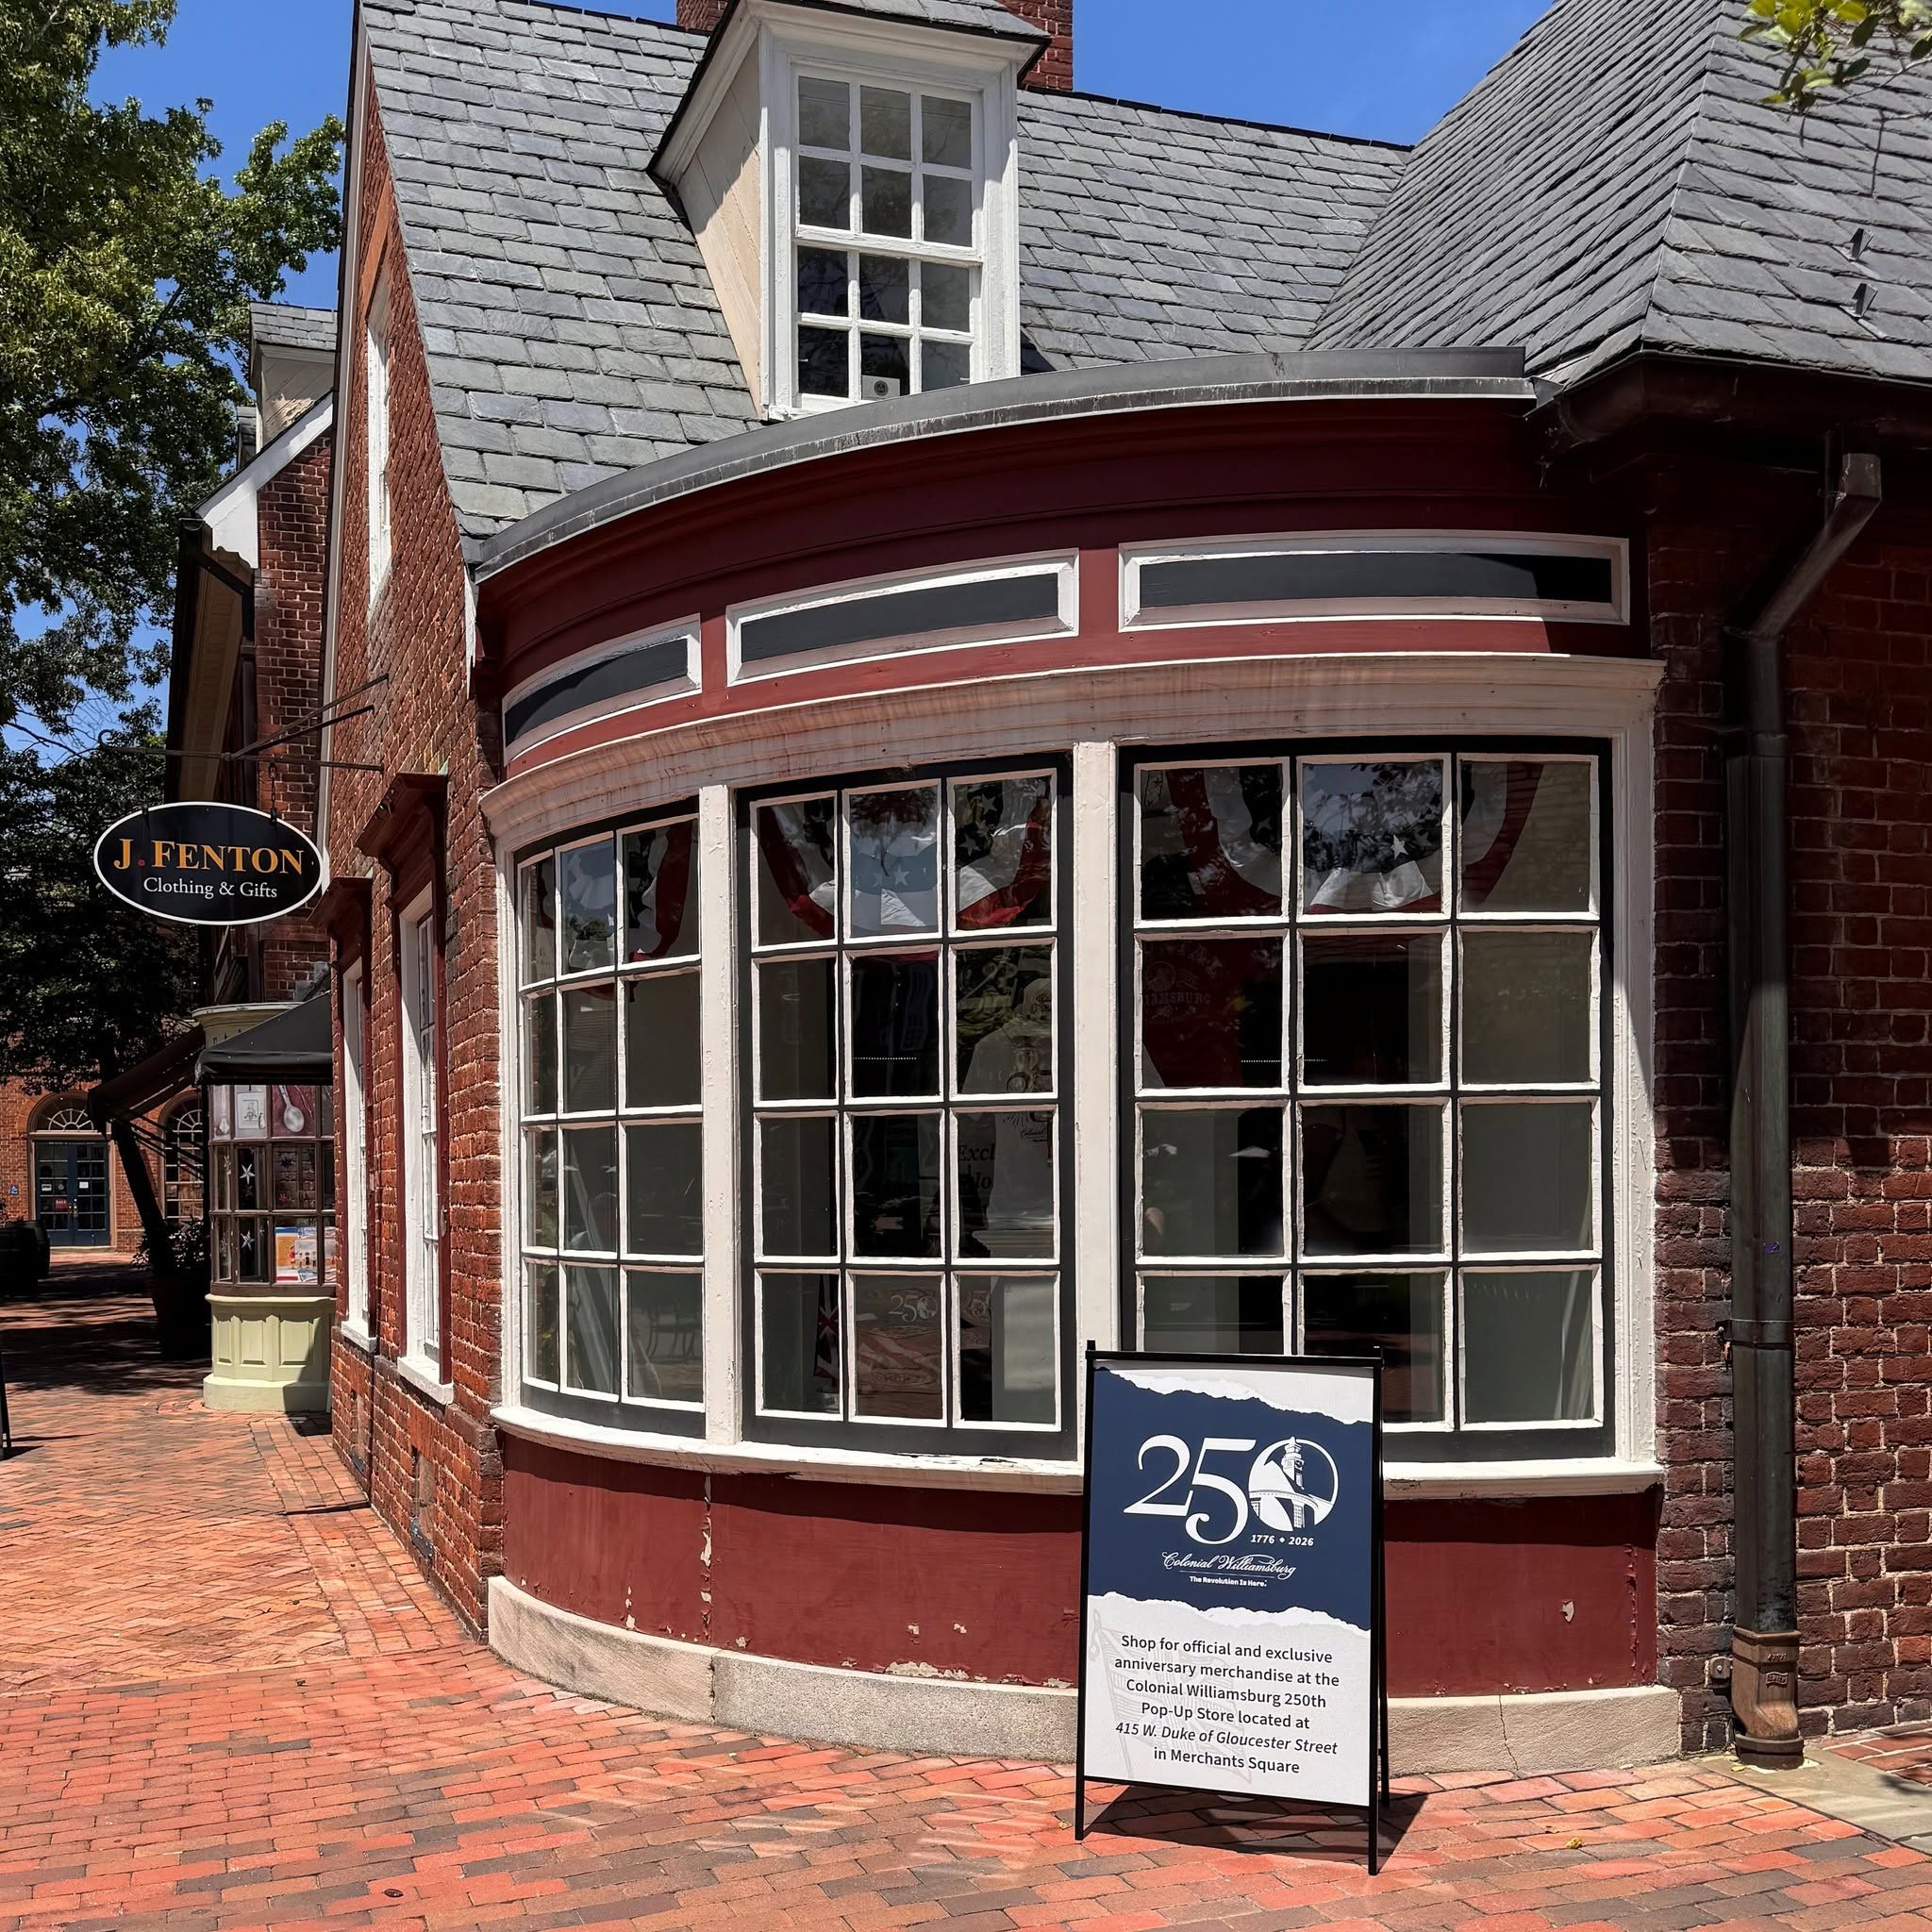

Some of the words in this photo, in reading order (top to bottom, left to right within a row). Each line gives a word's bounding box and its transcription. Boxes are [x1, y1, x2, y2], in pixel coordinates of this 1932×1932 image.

[151, 840, 305, 875] FENTON
[143, 876, 213, 899] Clothing
[219, 881, 235, 895] &
[240, 881, 277, 898] Gifts
[1123, 1434, 1339, 1544] 250
[1251, 1534, 1274, 1544] 1776
[1288, 1537, 1314, 1546] 2026
[1161, 1552, 1219, 1570] Colonial
[1218, 1554, 1296, 1580] Williamsburg
[1203, 1576, 1239, 1585] Revolution
[1121, 1635, 1156, 1650] Shop
[1159, 1638, 1180, 1651] for
[1183, 1641, 1231, 1656] official
[1235, 1645, 1261, 1657] and
[1265, 1647, 1333, 1663] exclusive
[1115, 1657, 1196, 1677] anniversary
[1200, 1665, 1293, 1683] merchandise
[1297, 1674, 1311, 1684] at
[1315, 1673, 1340, 1687] the
[1126, 1679, 1183, 1696] Colonial
[1186, 1684, 1281, 1707] Williamsburg
[1284, 1693, 1326, 1707] 250th
[1141, 1703, 1193, 1721] Pop-Up
[1197, 1707, 1234, 1723] Store
[1239, 1711, 1291, 1727] located
[1295, 1717, 1310, 1729] at
[1115, 1723, 1140, 1735] 415
[1142, 1724, 1158, 1738] W.
[1161, 1726, 1196, 1740] Duke
[1199, 1729, 1214, 1742] of
[1216, 1732, 1291, 1749] Gloucester
[1293, 1739, 1338, 1755] Street
[1154, 1746, 1166, 1760] in
[1171, 1749, 1245, 1768] Merchants
[1248, 1757, 1300, 1775] Square
